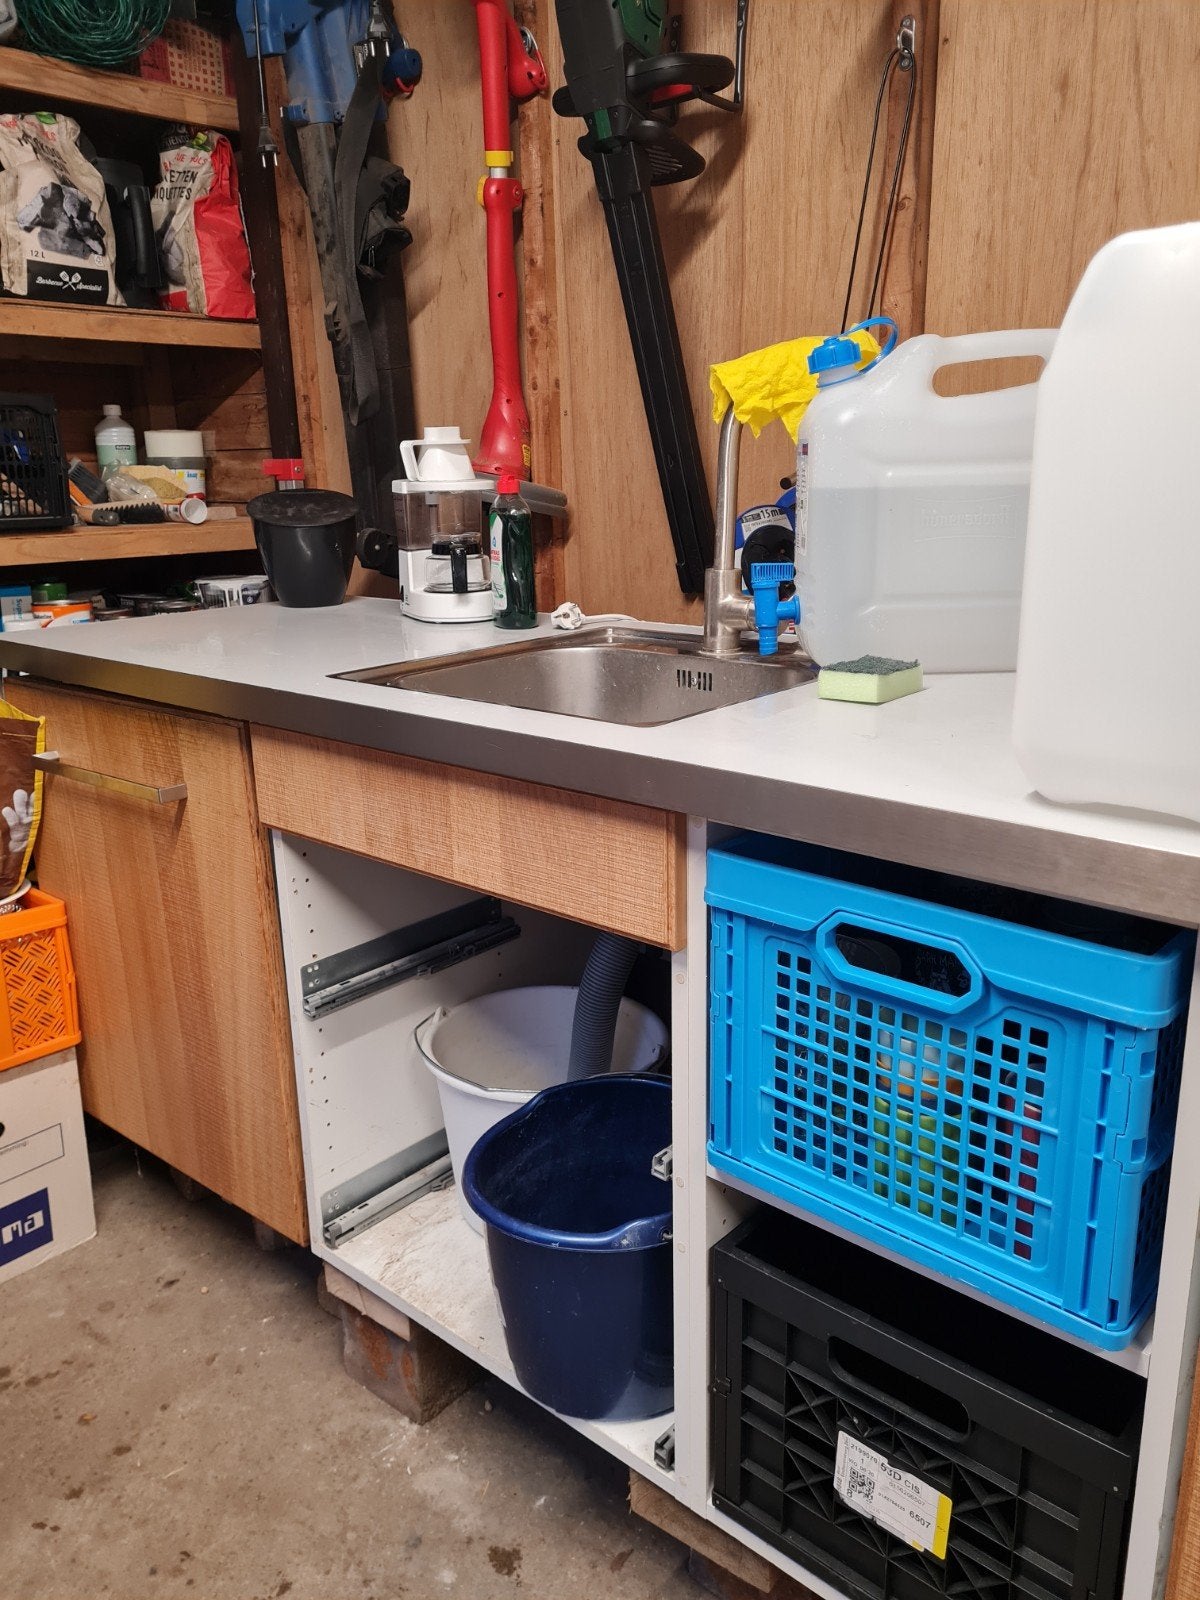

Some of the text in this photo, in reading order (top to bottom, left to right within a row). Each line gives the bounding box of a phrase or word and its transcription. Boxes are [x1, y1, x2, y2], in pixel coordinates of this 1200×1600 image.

[153, 187, 192, 202] IQUETTES
[904, 1480, 921, 1494] CIS
[909, 1510, 931, 1529] 6507
